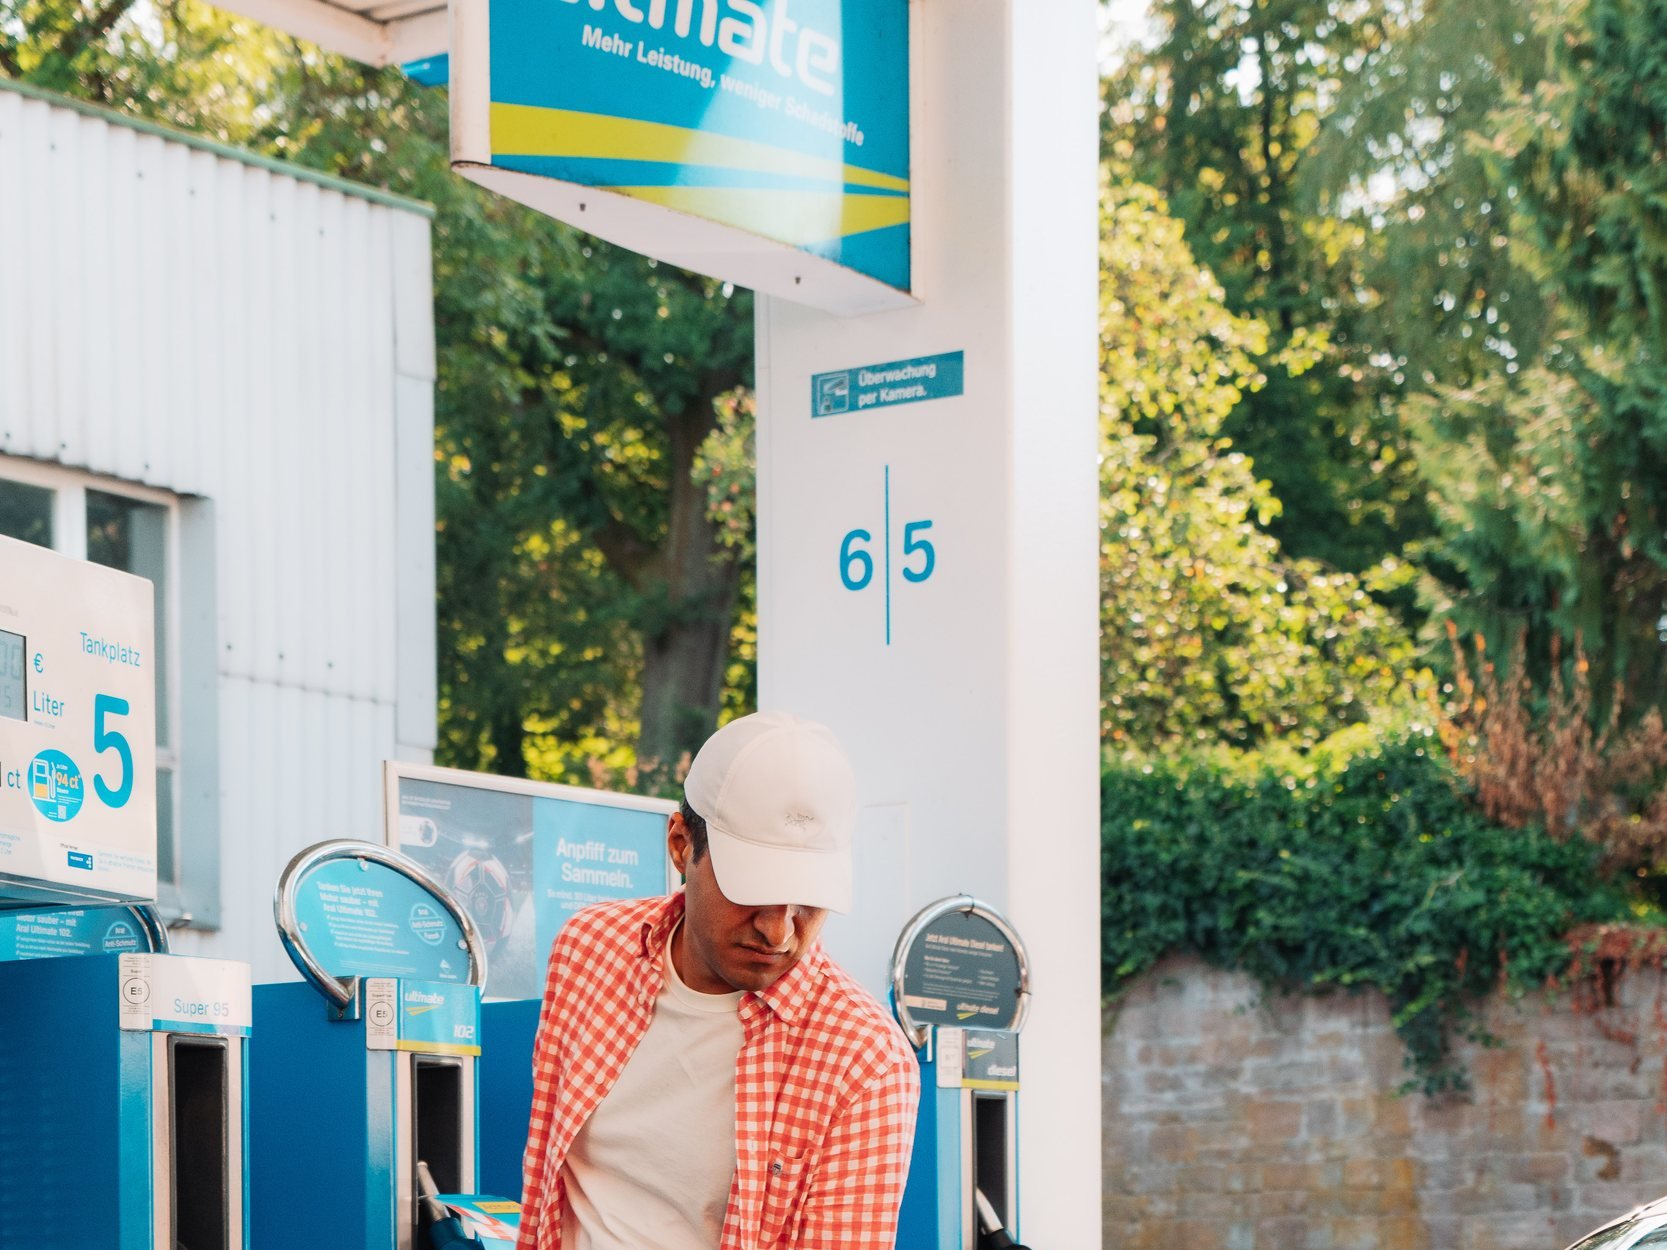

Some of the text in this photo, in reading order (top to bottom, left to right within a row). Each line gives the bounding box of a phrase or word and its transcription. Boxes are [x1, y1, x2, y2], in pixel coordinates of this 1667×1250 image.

[582, 24, 864, 146] Mehr Leistung, weniger Schadstoffe
[859, 364, 936, 387] Überwachung
[859, 384, 927, 408] per Kamera.
[839, 528, 873, 591] 6
[902, 519, 935, 583] 5
[80, 631, 141, 667] Tankplatz
[33, 652, 45, 674] €
[33, 689, 65, 717] Liter
[93, 693, 134, 809] 5
[7, 769, 21, 789] ct
[556, 837, 639, 865] Anpfiff zum
[561, 861, 634, 888] Sammeln.
[130, 986, 143, 997] E5
[404, 990, 444, 1005] ultimate
[174, 998, 230, 1017] Super 95
[453, 1024, 474, 1039] 102
